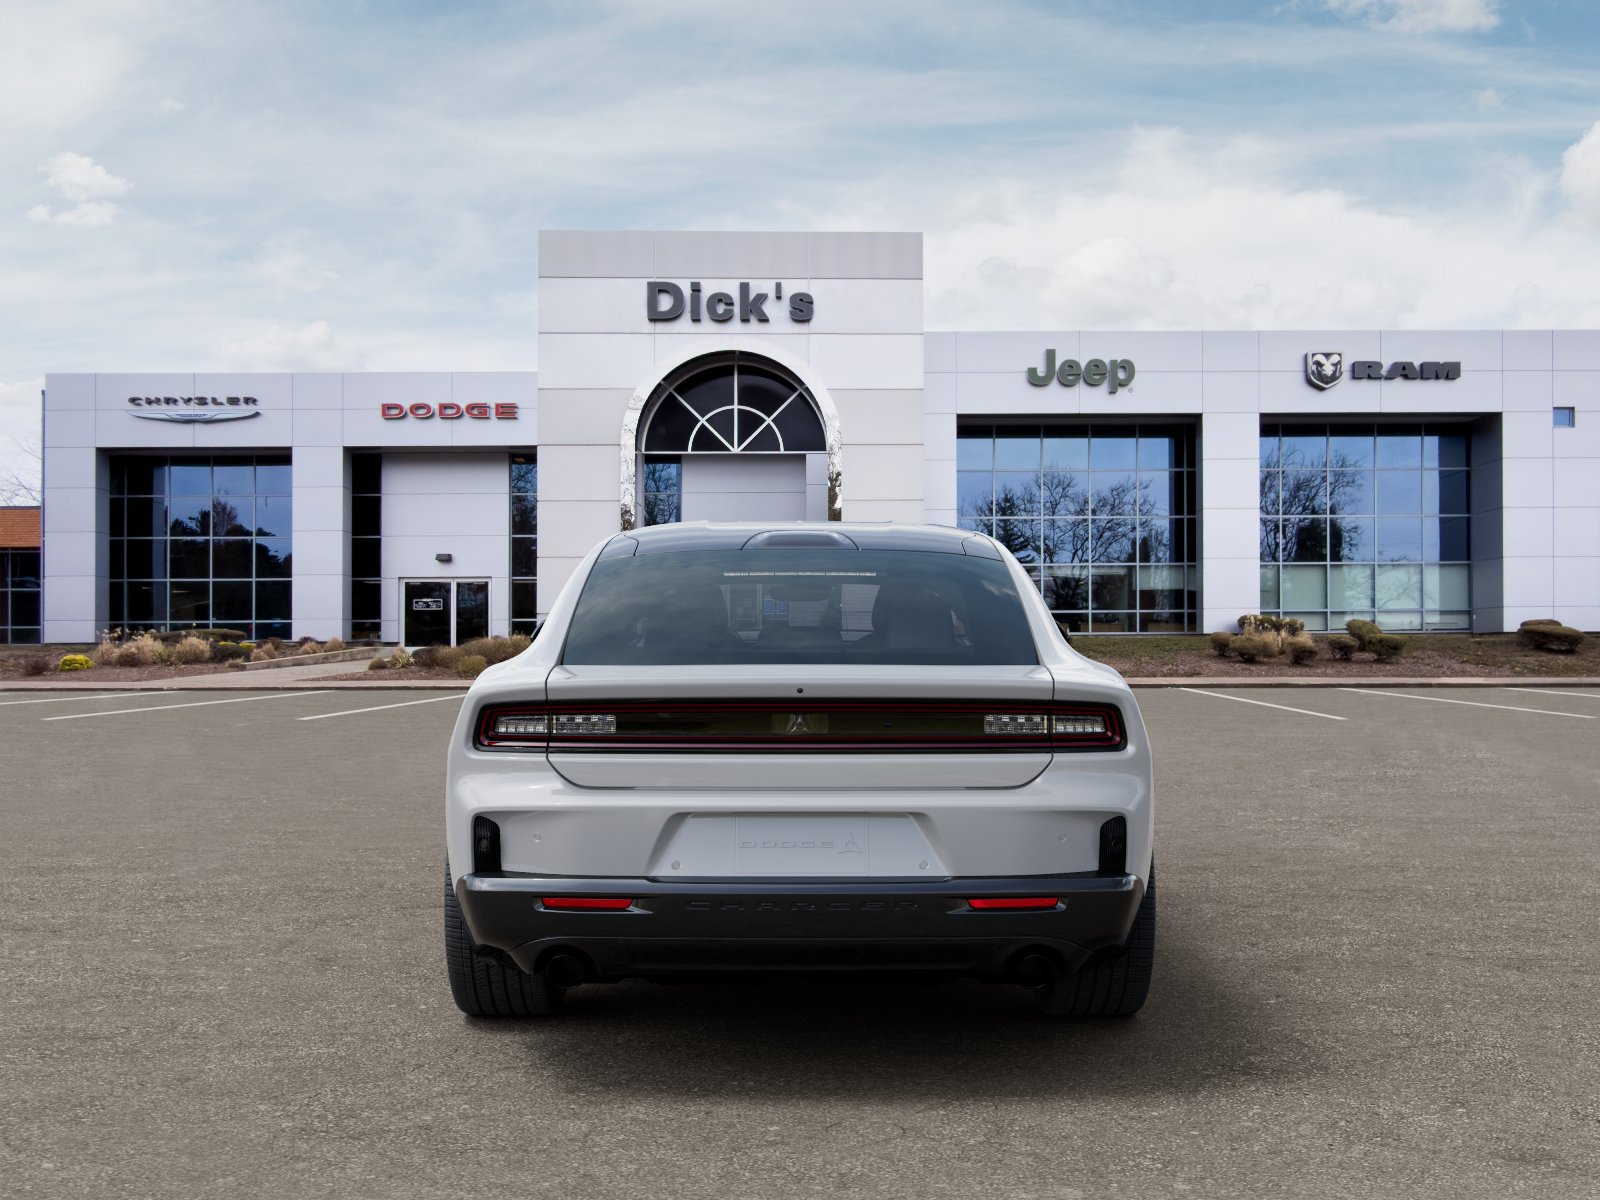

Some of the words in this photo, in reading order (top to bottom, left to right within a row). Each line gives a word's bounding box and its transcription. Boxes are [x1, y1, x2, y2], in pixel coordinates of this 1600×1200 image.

[647, 281, 814, 322] Dick's
[1027, 348, 1136, 394] Jeep
[1352, 360, 1461, 380] RAM
[128, 396, 258, 407] CHRYSLER
[381, 402, 518, 419] DODGE
[739, 840, 834, 849] DODGE
